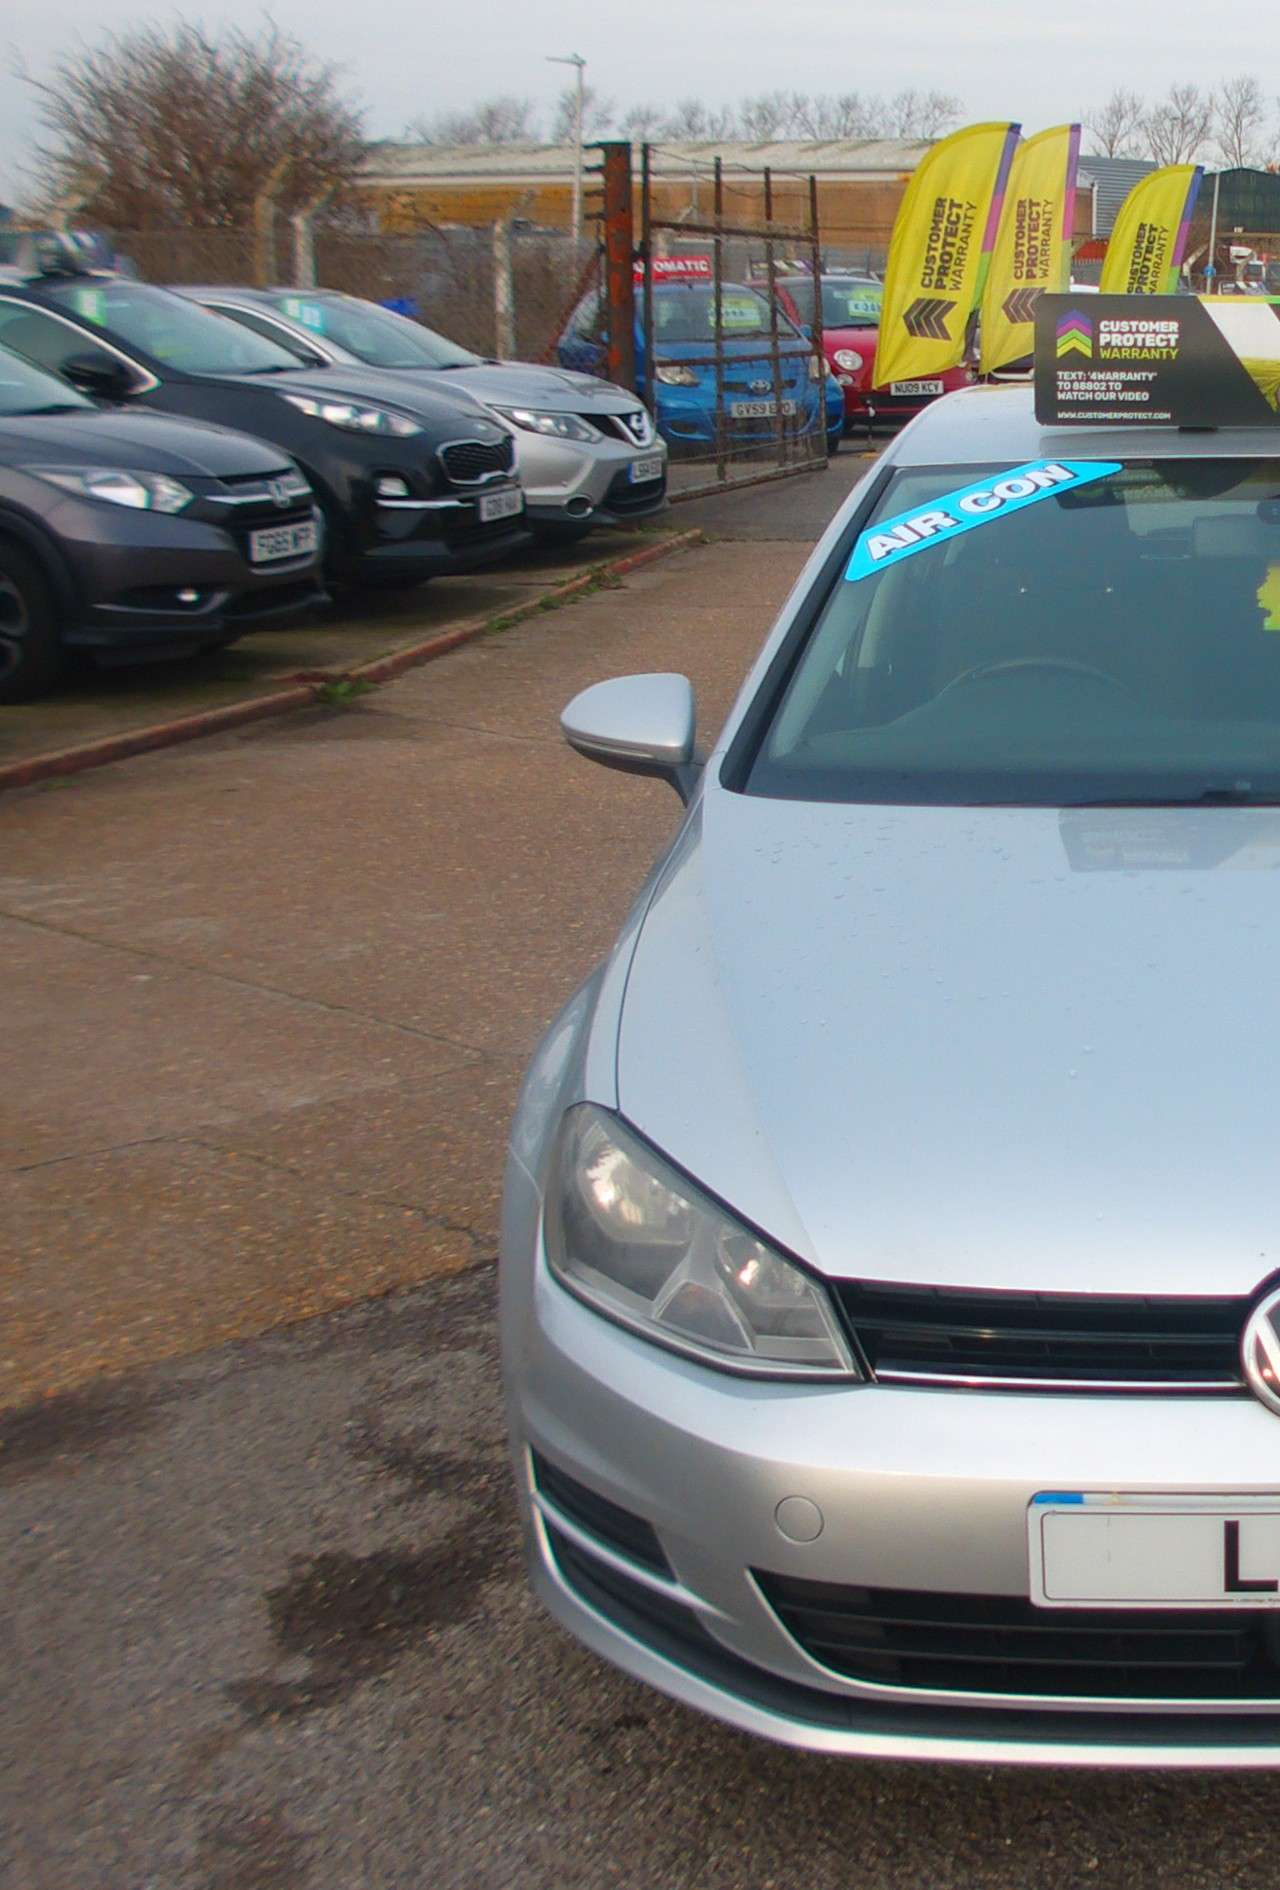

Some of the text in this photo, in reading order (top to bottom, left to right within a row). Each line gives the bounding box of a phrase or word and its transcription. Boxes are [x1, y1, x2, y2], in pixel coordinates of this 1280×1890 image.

[920, 197, 947, 288] CUSTOMER
[934, 198, 963, 290] PROTECT
[948, 201, 977, 291] WARRANTY
[1013, 199, 1027, 280] CUSTOMER
[1025, 199, 1041, 280] PROTECT
[1039, 199, 1053, 279] WARRANTY
[1135, 223, 1159, 294] PROTECT
[1099, 320, 1179, 333] CUSTOMER
[1099, 333, 1179, 347] PROTECT
[1099, 348, 1179, 360] WARRANTY
[1056, 371, 1087, 381] TEXT:
[1056, 382, 1071, 391] TO
[1108, 382, 1122, 391] TO
[1056, 391, 1150, 401] WATCH OUR VIDEO
[866, 463, 1079, 561] AIR CON
